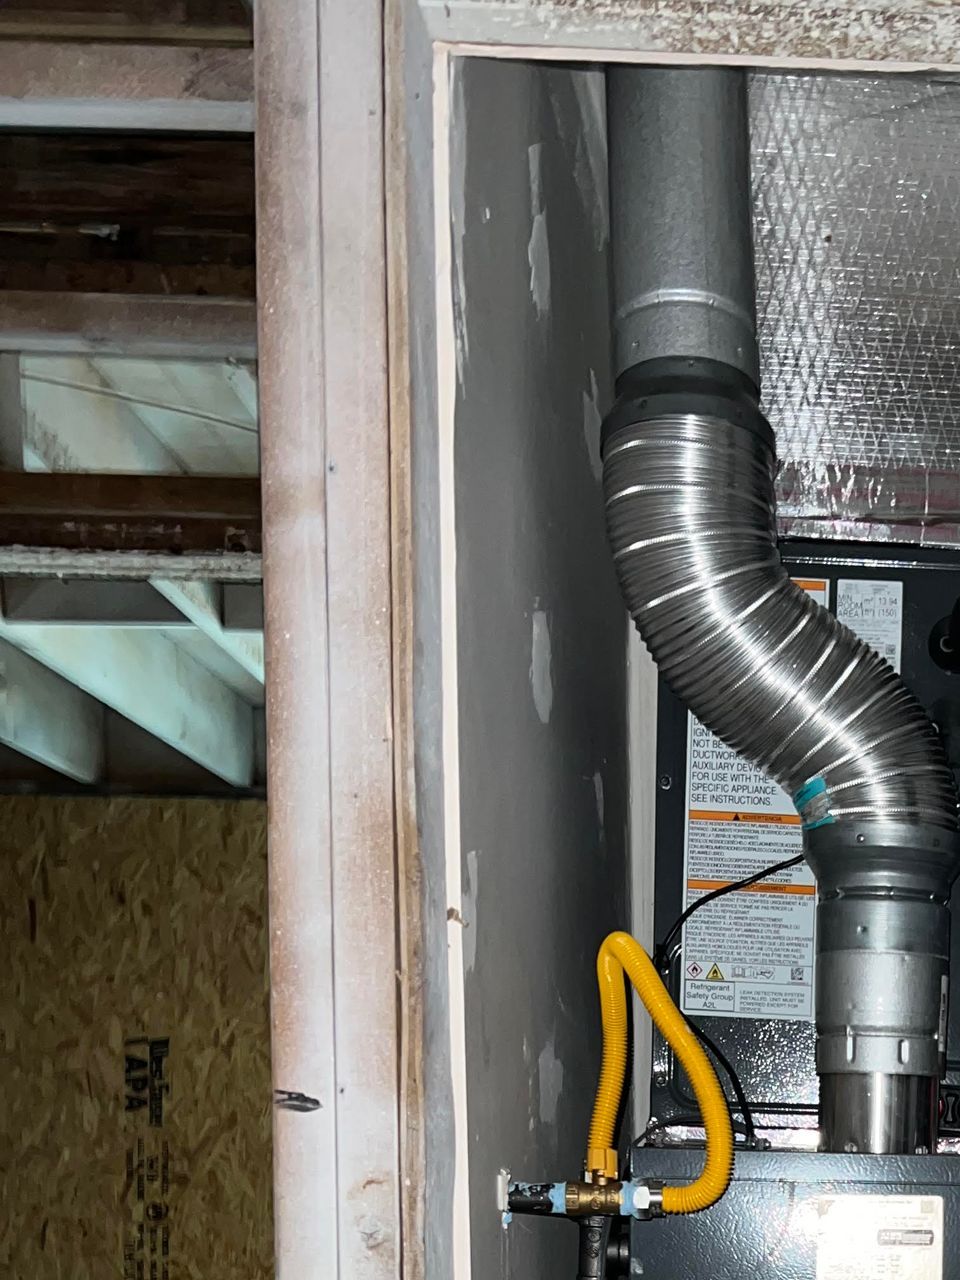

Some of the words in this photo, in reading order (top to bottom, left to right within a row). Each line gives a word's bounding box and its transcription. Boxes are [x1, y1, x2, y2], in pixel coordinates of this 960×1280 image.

[838, 602, 863, 610] ROOM
[838, 609, 859, 617] AREA
[878, 608, 897, 618] (150)
[693, 739, 710, 748] NOT
[712, 740, 722, 749] BE
[692, 761, 735, 771] AUXILIARY
[692, 772, 710, 781] FOR
[711, 773, 728, 782] USE
[730, 774, 752, 783] WITH
[753, 775, 770, 784] THE
[691, 782, 729, 793] SPECIFIC
[691, 794, 708, 803] SEE
[710, 795, 773, 806] INSTRUCTIONS.
[690, 983, 730, 992] Refrigerant
[686, 992, 709, 1001] Safety
[711, 993, 734, 1003] Group
[125, 1056, 148, 1112] APA
